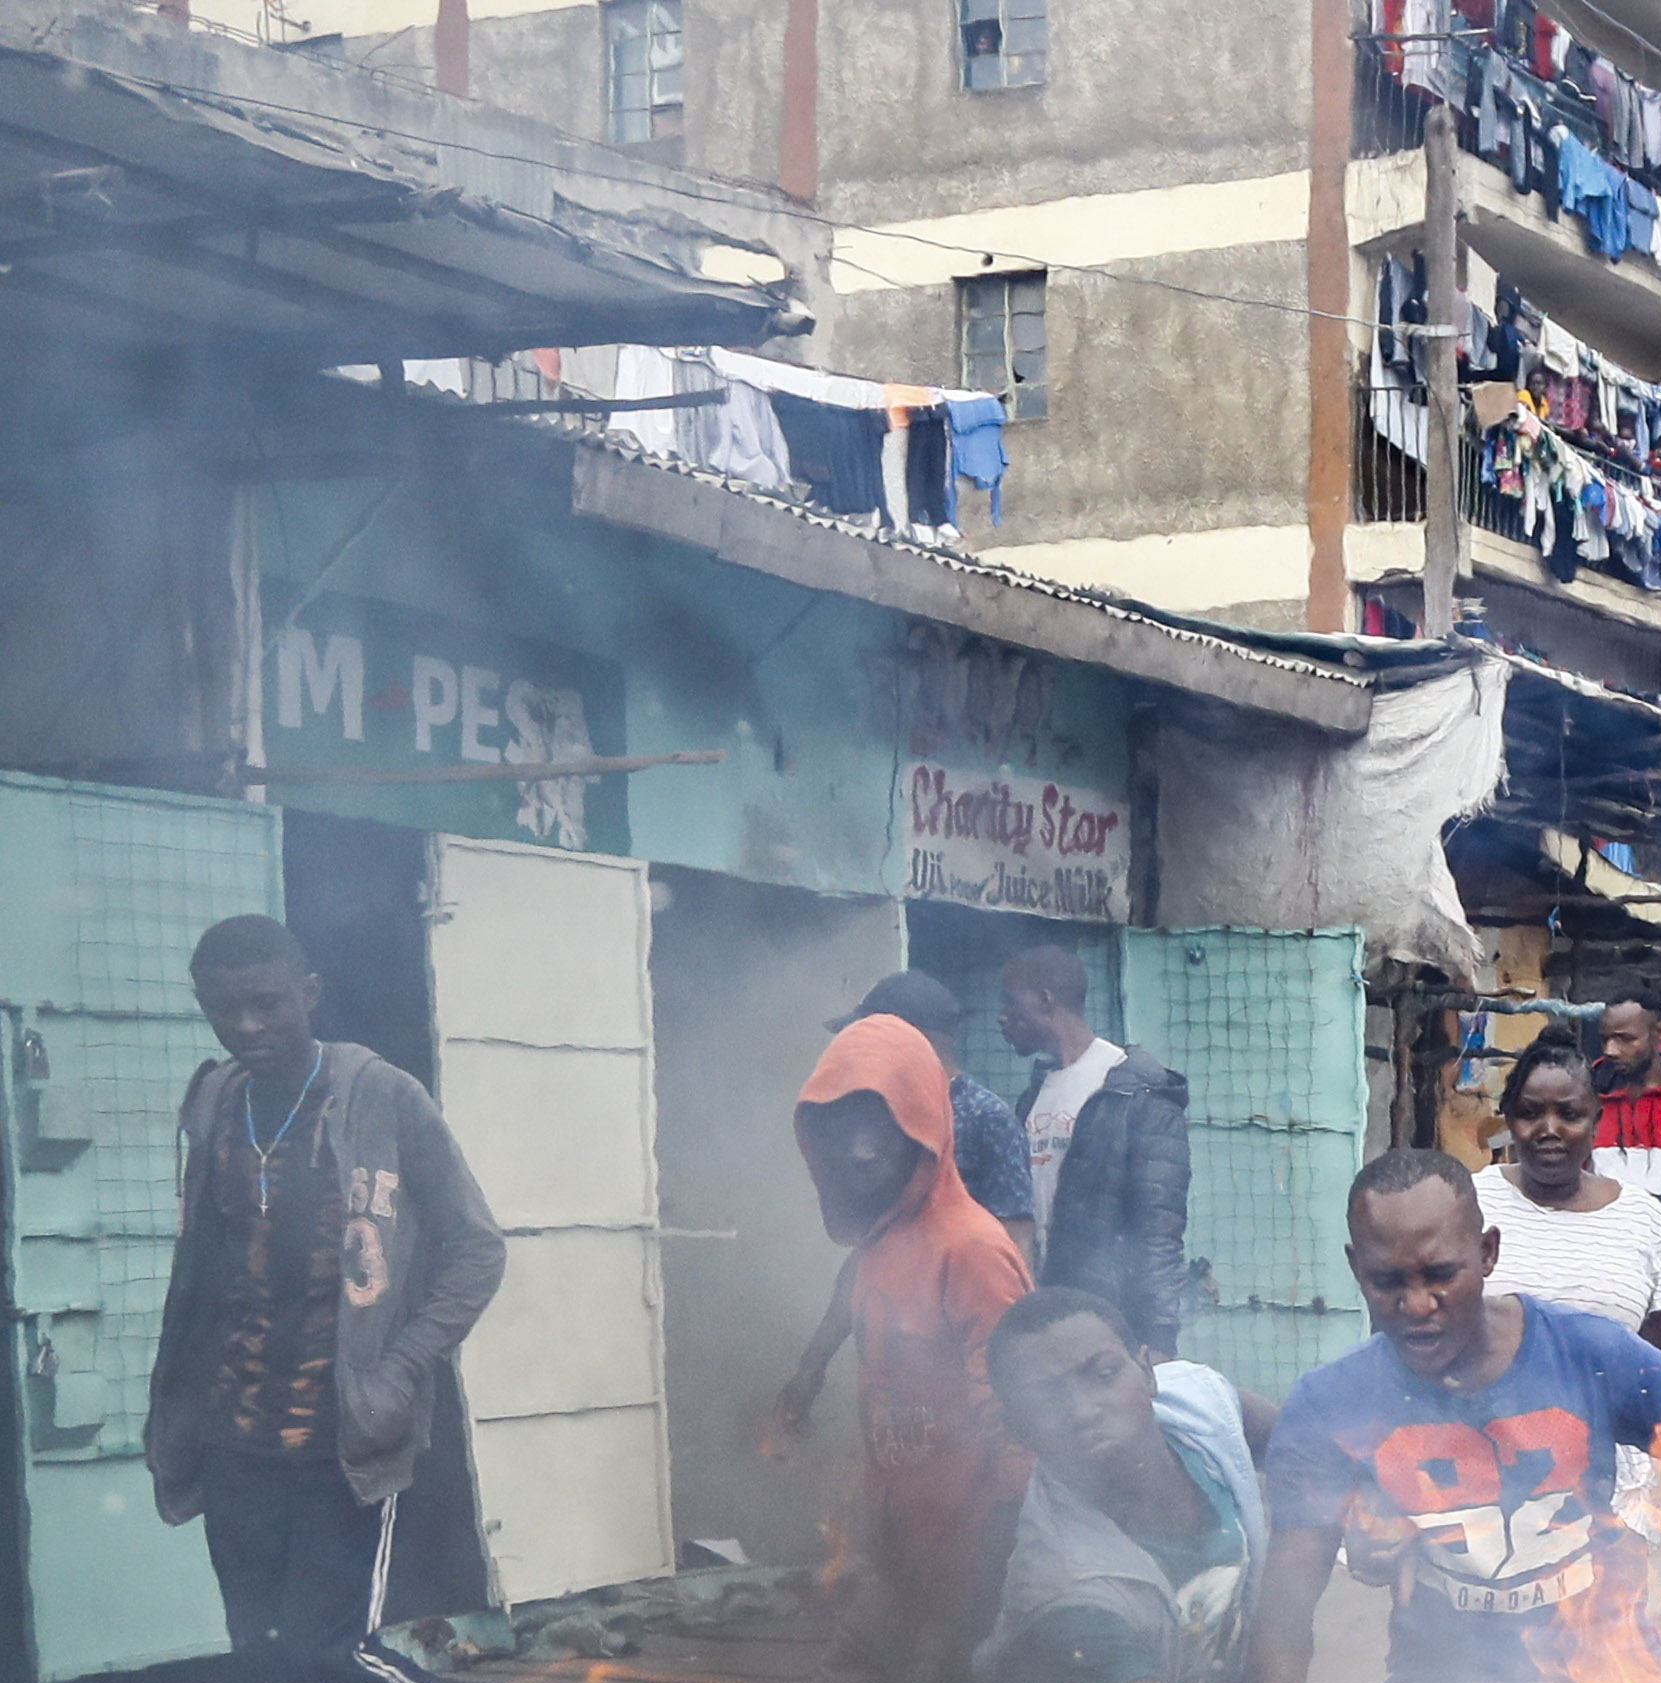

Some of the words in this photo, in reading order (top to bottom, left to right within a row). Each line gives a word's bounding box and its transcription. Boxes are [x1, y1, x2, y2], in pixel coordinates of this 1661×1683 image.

[912, 765, 1034, 855] Charity
[1039, 782, 1119, 856] Star
[987, 862, 1050, 907] Juice
